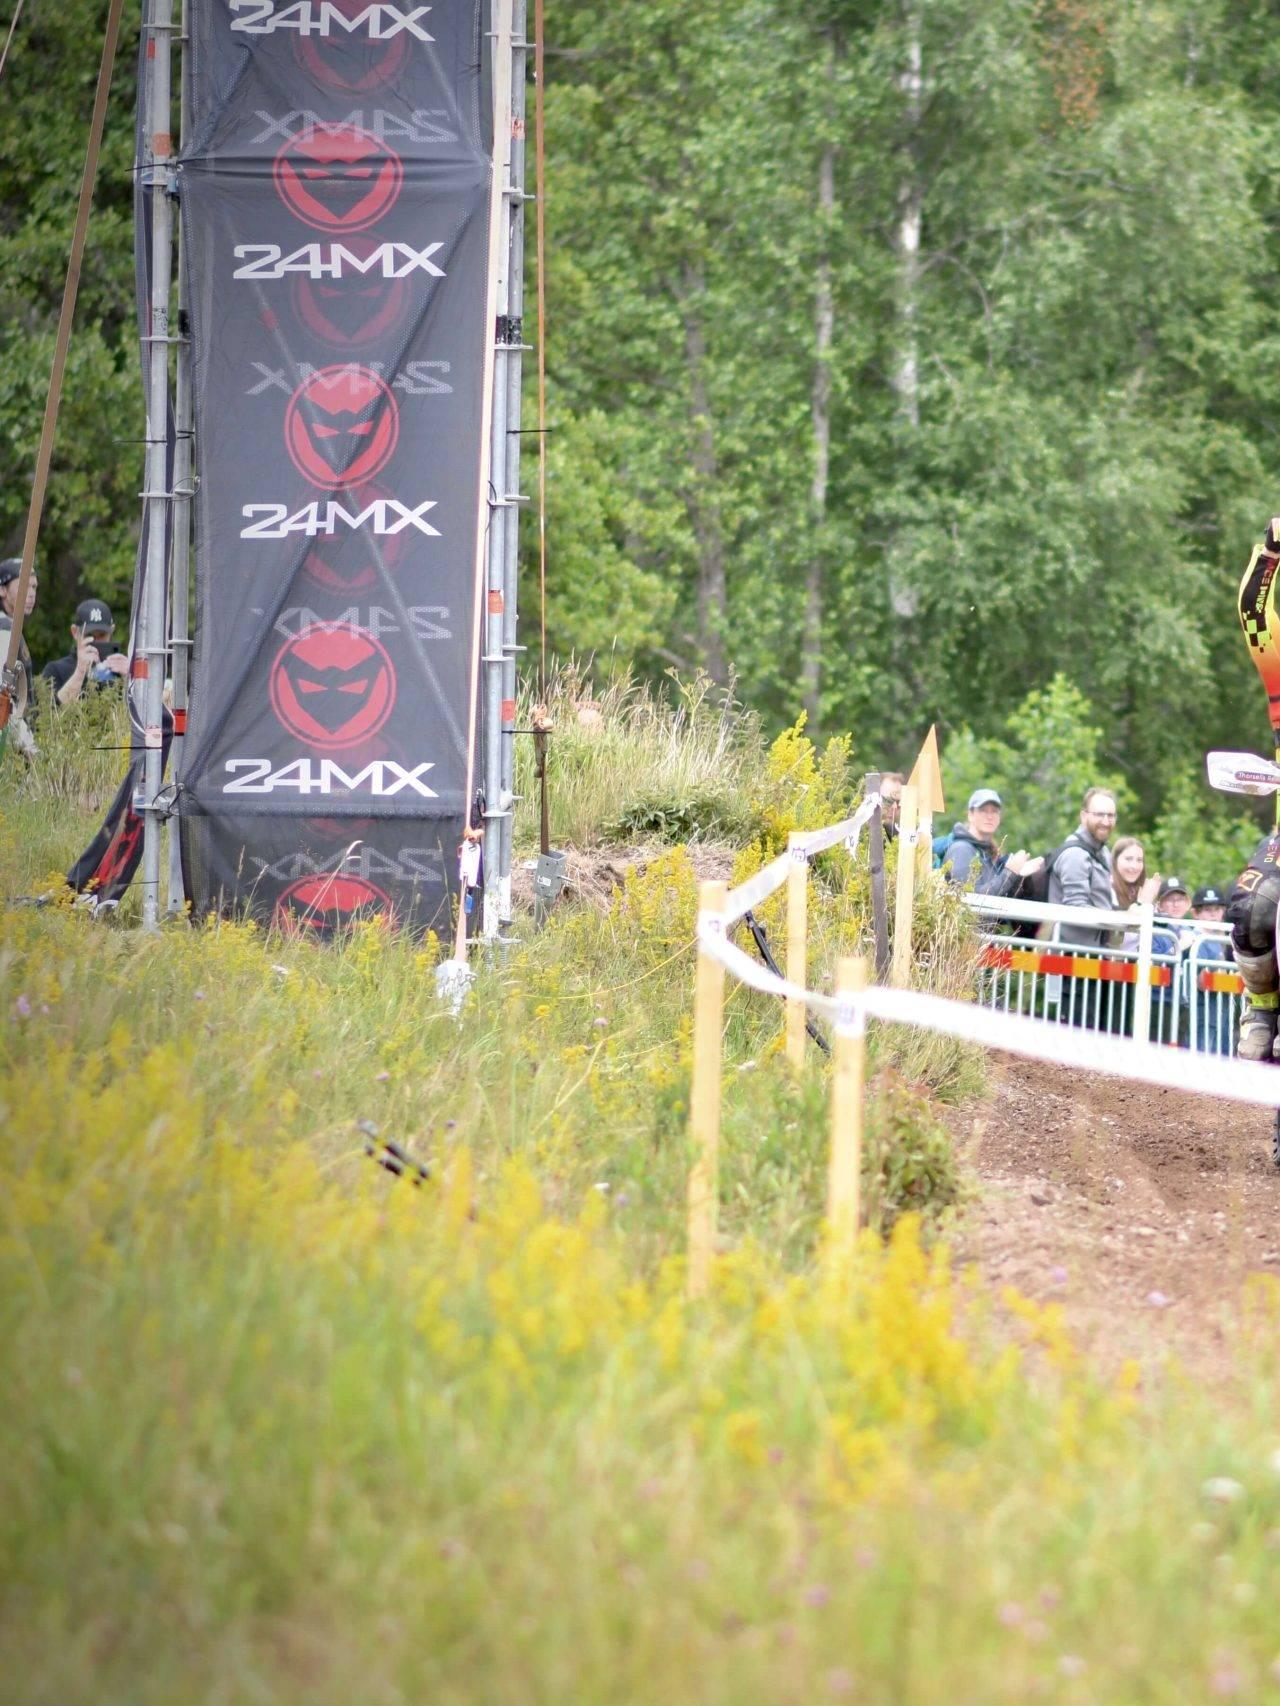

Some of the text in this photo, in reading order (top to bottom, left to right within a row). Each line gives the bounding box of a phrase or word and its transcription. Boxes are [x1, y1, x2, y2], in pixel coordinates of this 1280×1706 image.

[229, 0, 436, 41] 24MX
[233, 242, 447, 279] 24MX
[240, 499, 442, 538] 24MX
[222, 758, 440, 798] 24MX
